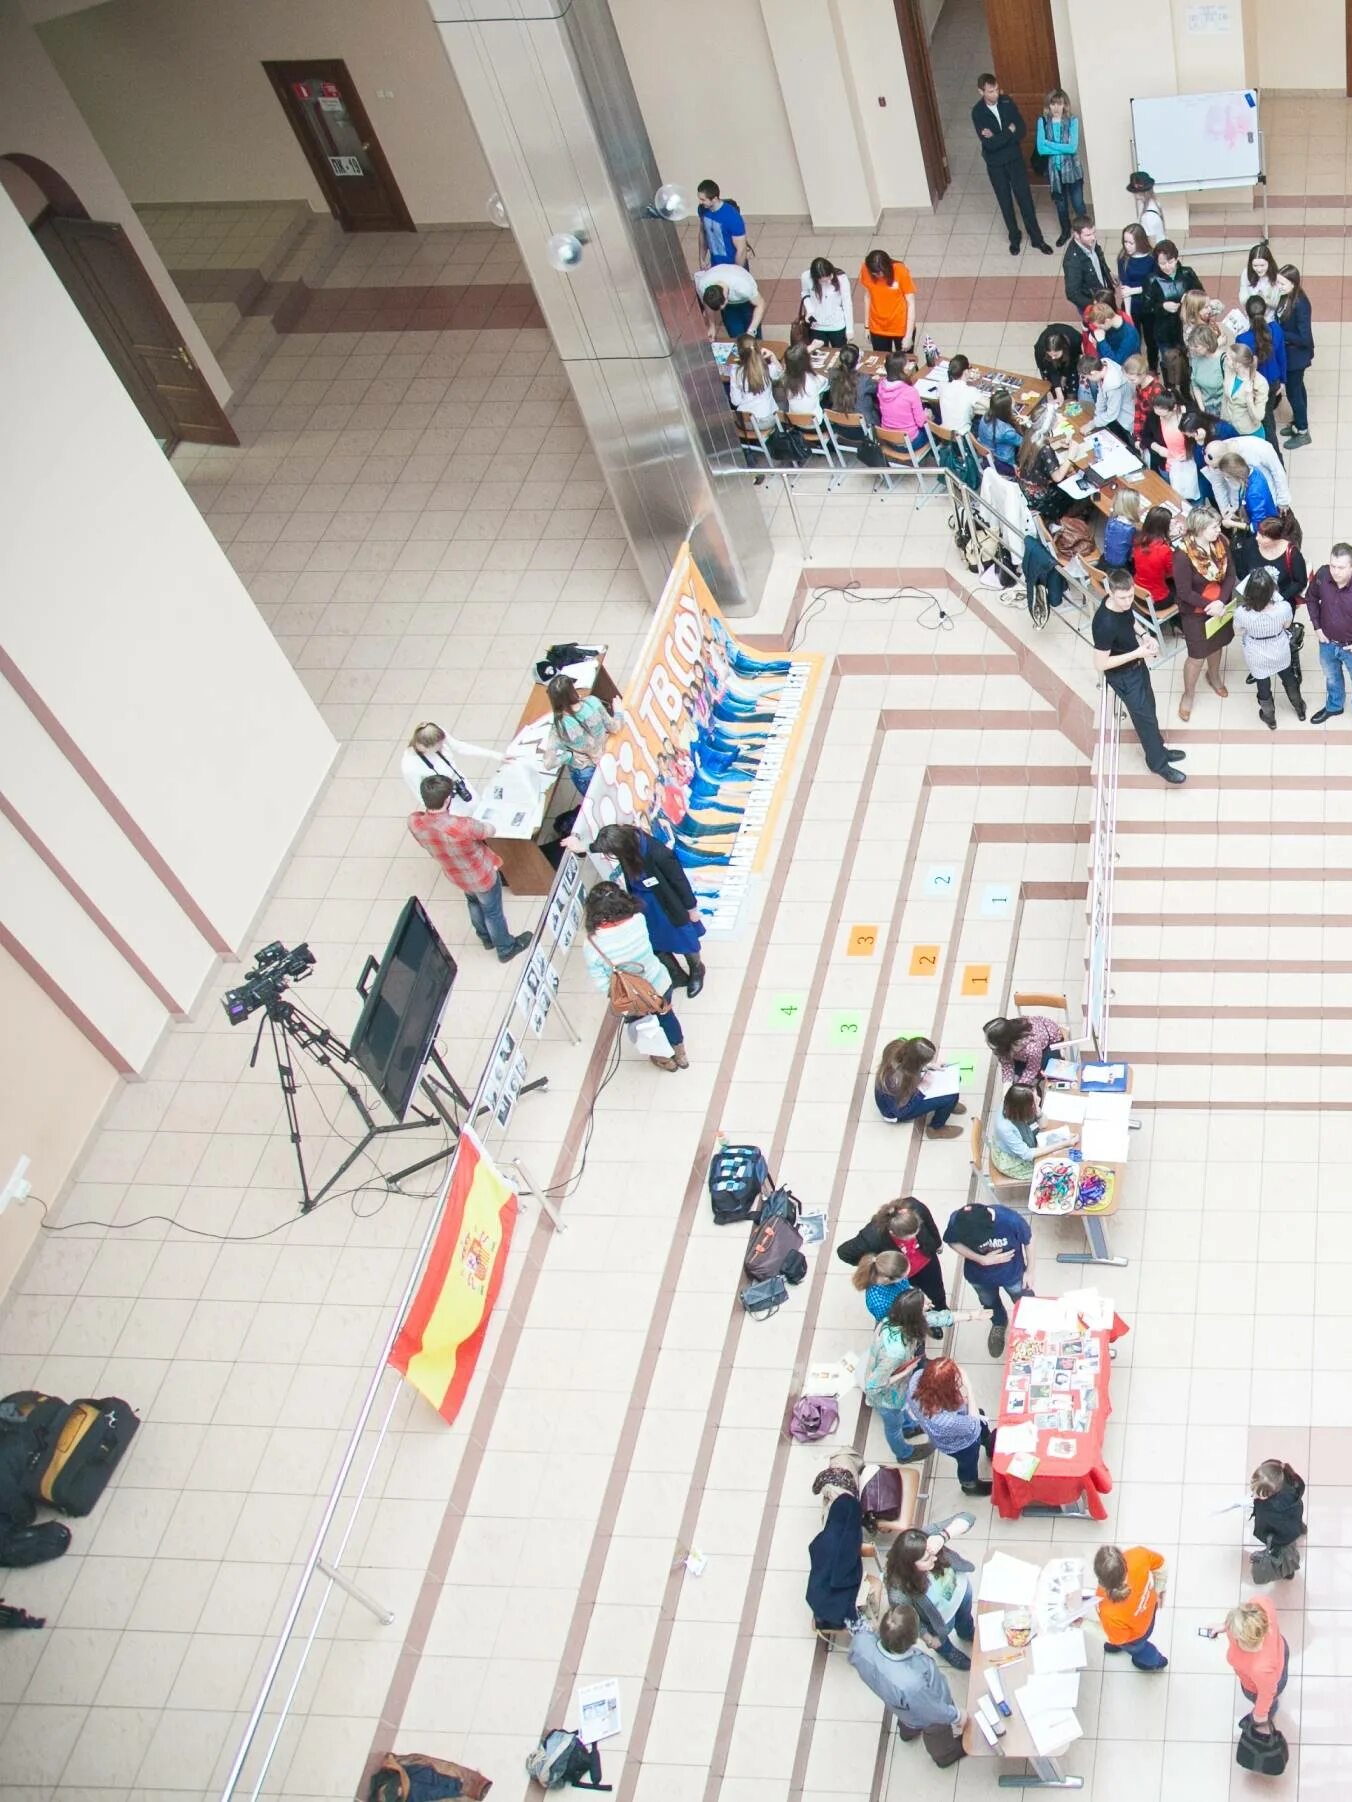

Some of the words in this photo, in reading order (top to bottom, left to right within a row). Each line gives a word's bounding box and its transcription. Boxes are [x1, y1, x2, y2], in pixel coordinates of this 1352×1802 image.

[935, 876, 951, 884] 2
[858, 936, 873, 944] 3
[781, 1006, 797, 1015] 4
[841, 1024, 858, 1032] 3
